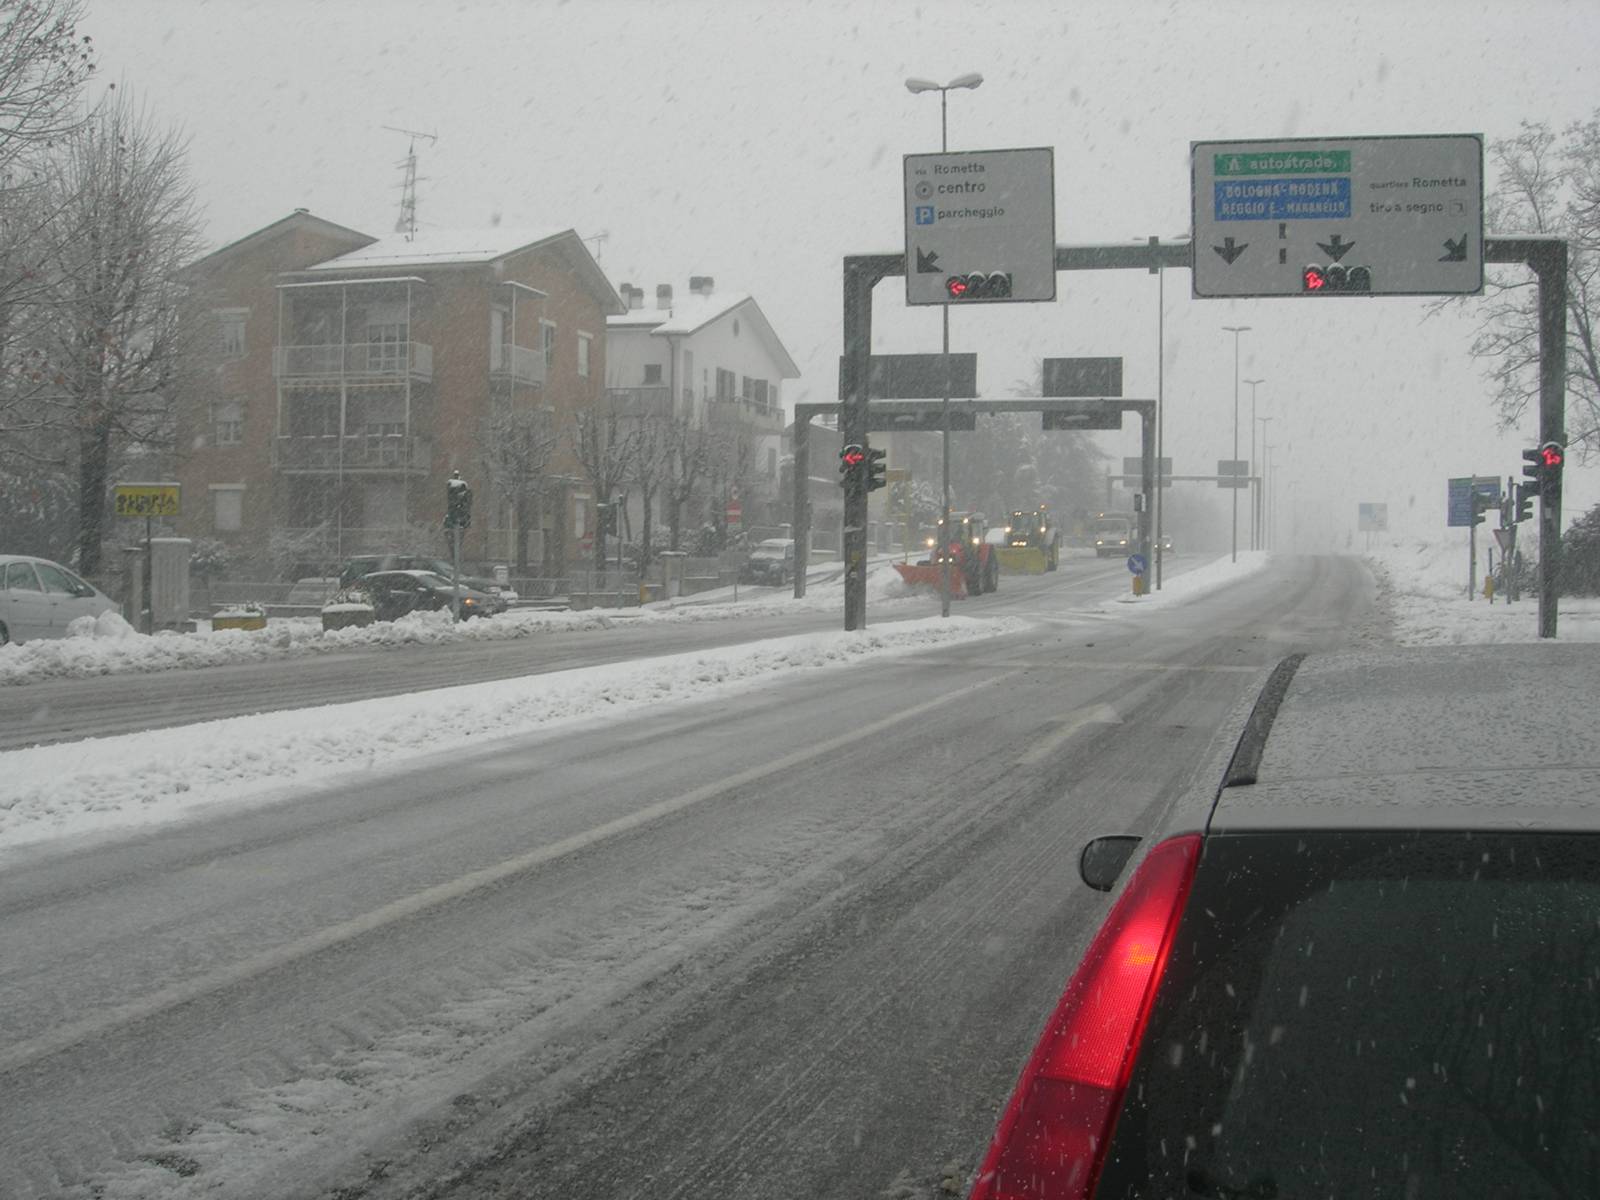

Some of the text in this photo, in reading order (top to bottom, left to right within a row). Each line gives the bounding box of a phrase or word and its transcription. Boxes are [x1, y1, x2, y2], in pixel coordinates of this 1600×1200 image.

[934, 162, 985, 175] Rometta
[1228, 158, 1241, 172] A
[937, 181, 986, 194] centro
[1412, 177, 1467, 188] Rometta
[920, 206, 1005, 223] P parcheggio
[1222, 202, 1265, 216] REGGIO
[1369, 202, 1444, 214] tiro a segno
